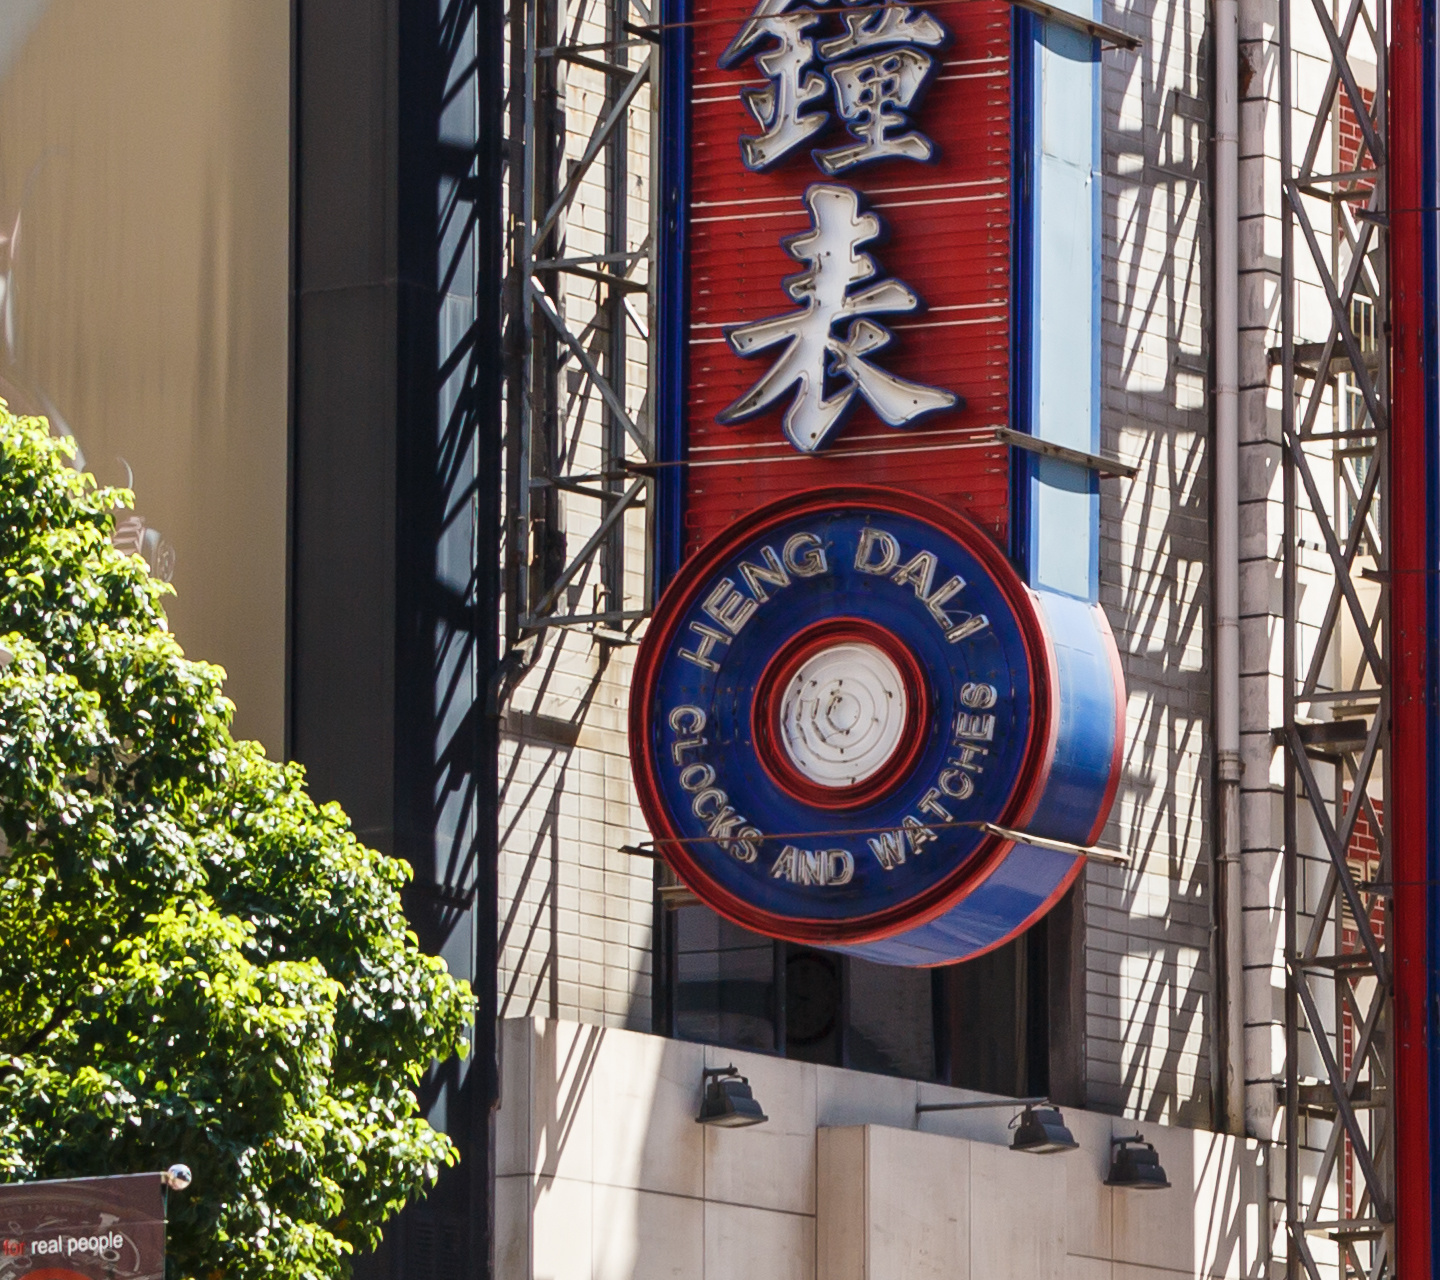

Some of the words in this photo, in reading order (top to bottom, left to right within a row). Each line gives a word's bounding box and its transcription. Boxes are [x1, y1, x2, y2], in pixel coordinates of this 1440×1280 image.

[678, 533, 827, 672] HENG
[854, 528, 990, 644] DALI
[668, 706, 764, 863] CLOCKS
[771, 846, 854, 885] AND
[867, 682, 996, 870] WATCHES
[31, 1235, 63, 1255] real
[67, 1231, 124, 1257] people
